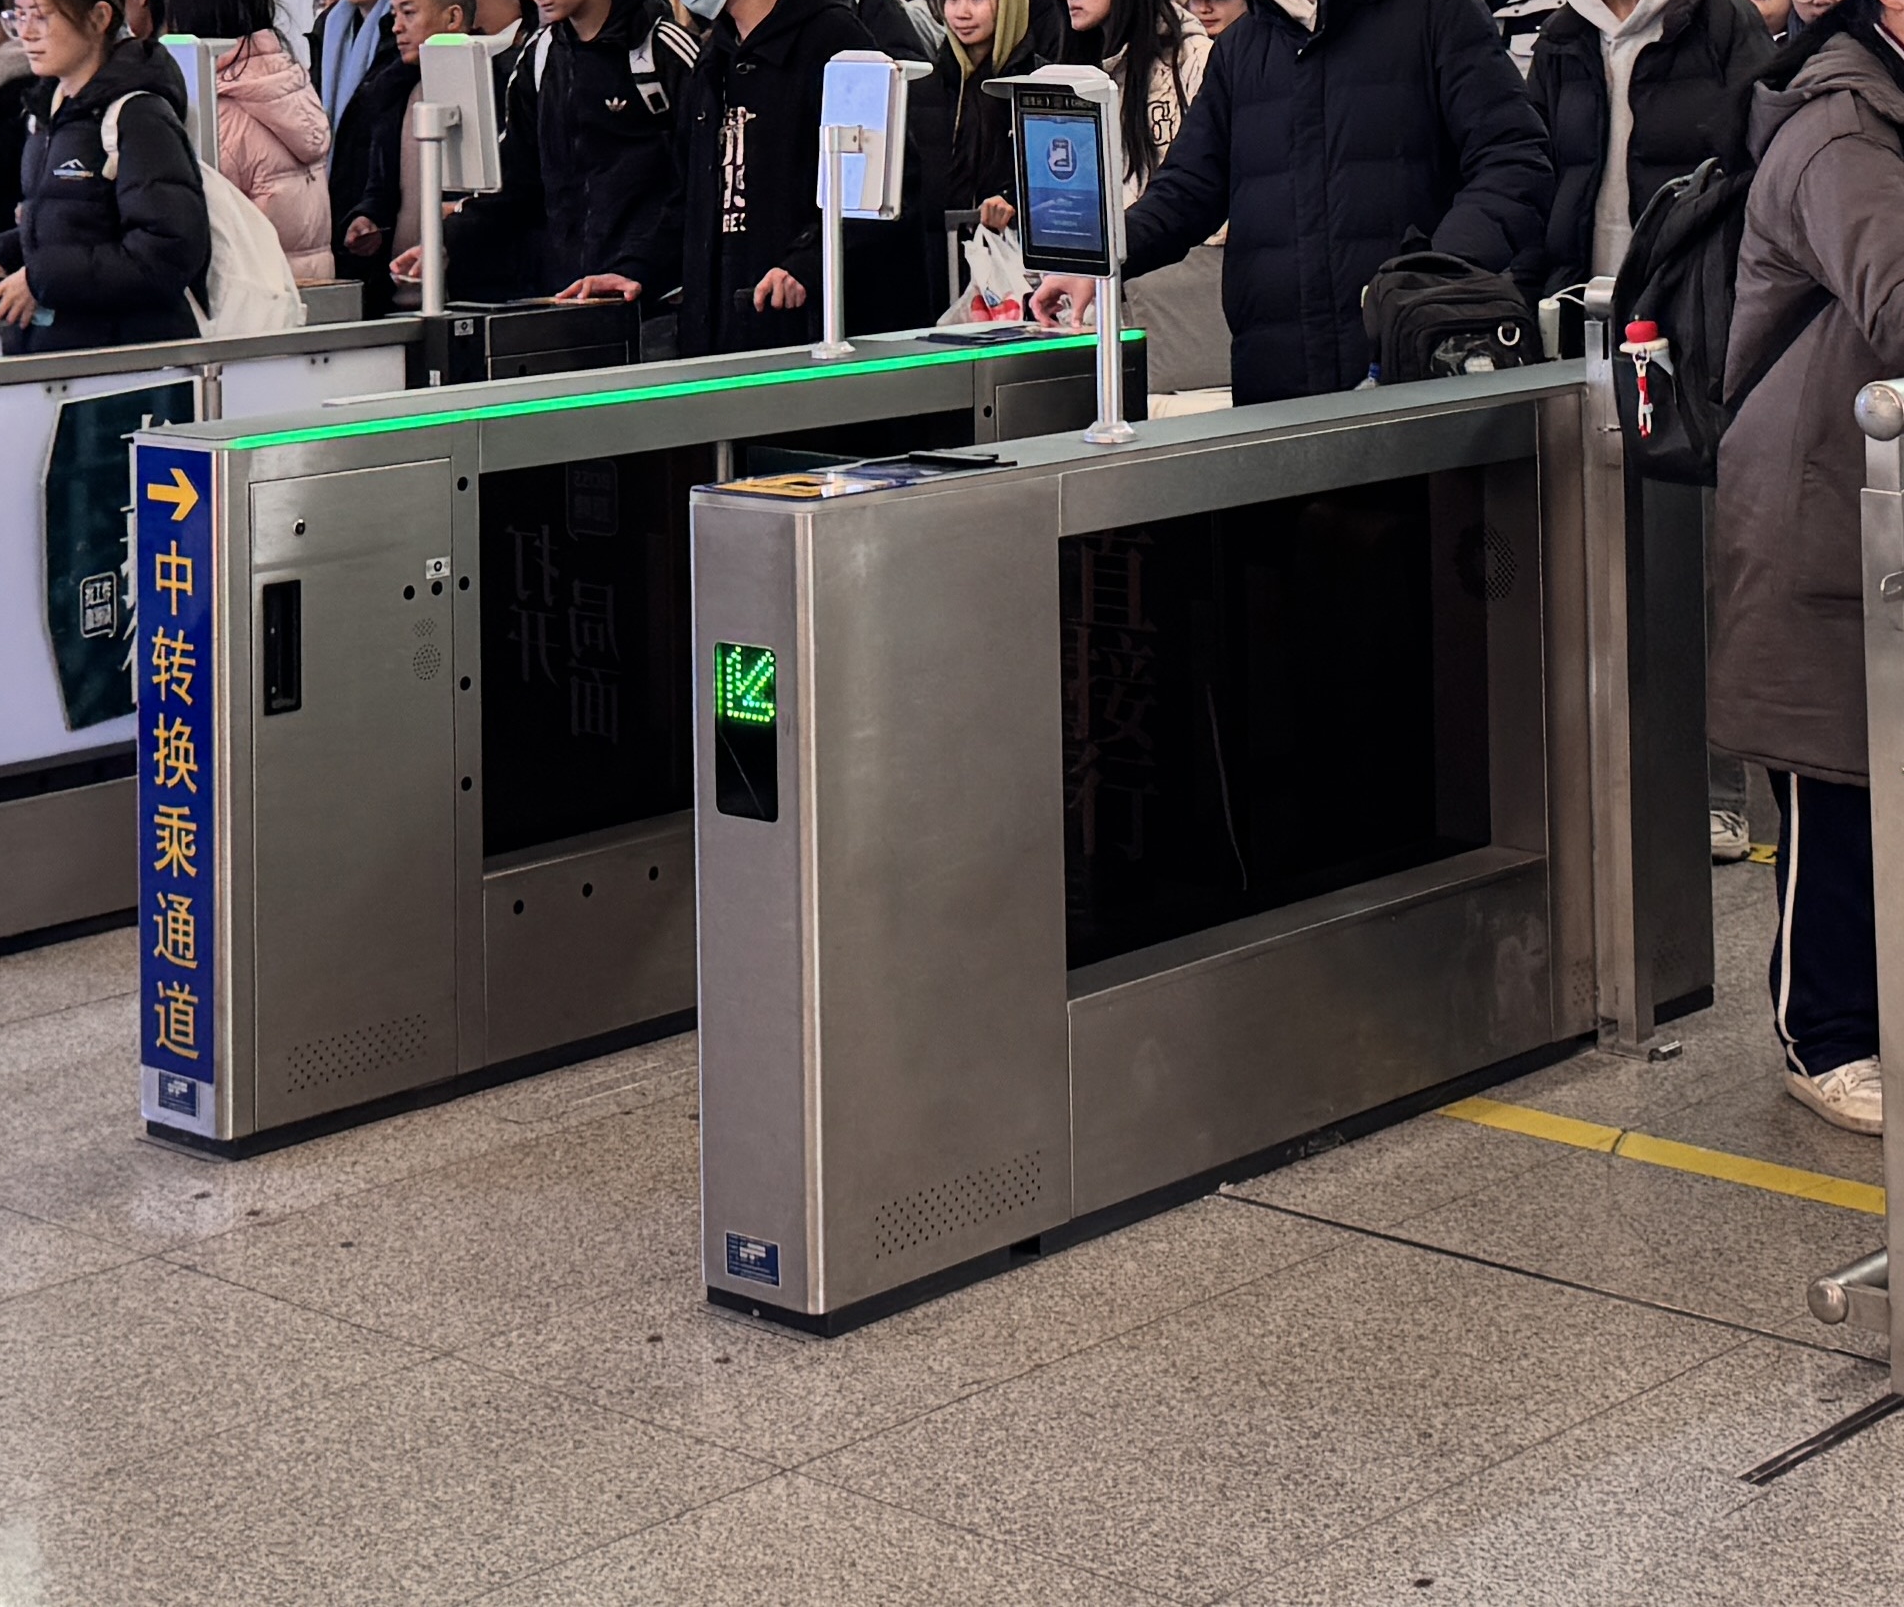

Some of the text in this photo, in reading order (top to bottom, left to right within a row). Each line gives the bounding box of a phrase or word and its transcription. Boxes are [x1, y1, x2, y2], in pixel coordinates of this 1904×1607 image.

[150, 540, 200, 1060] 中转换乘通道
